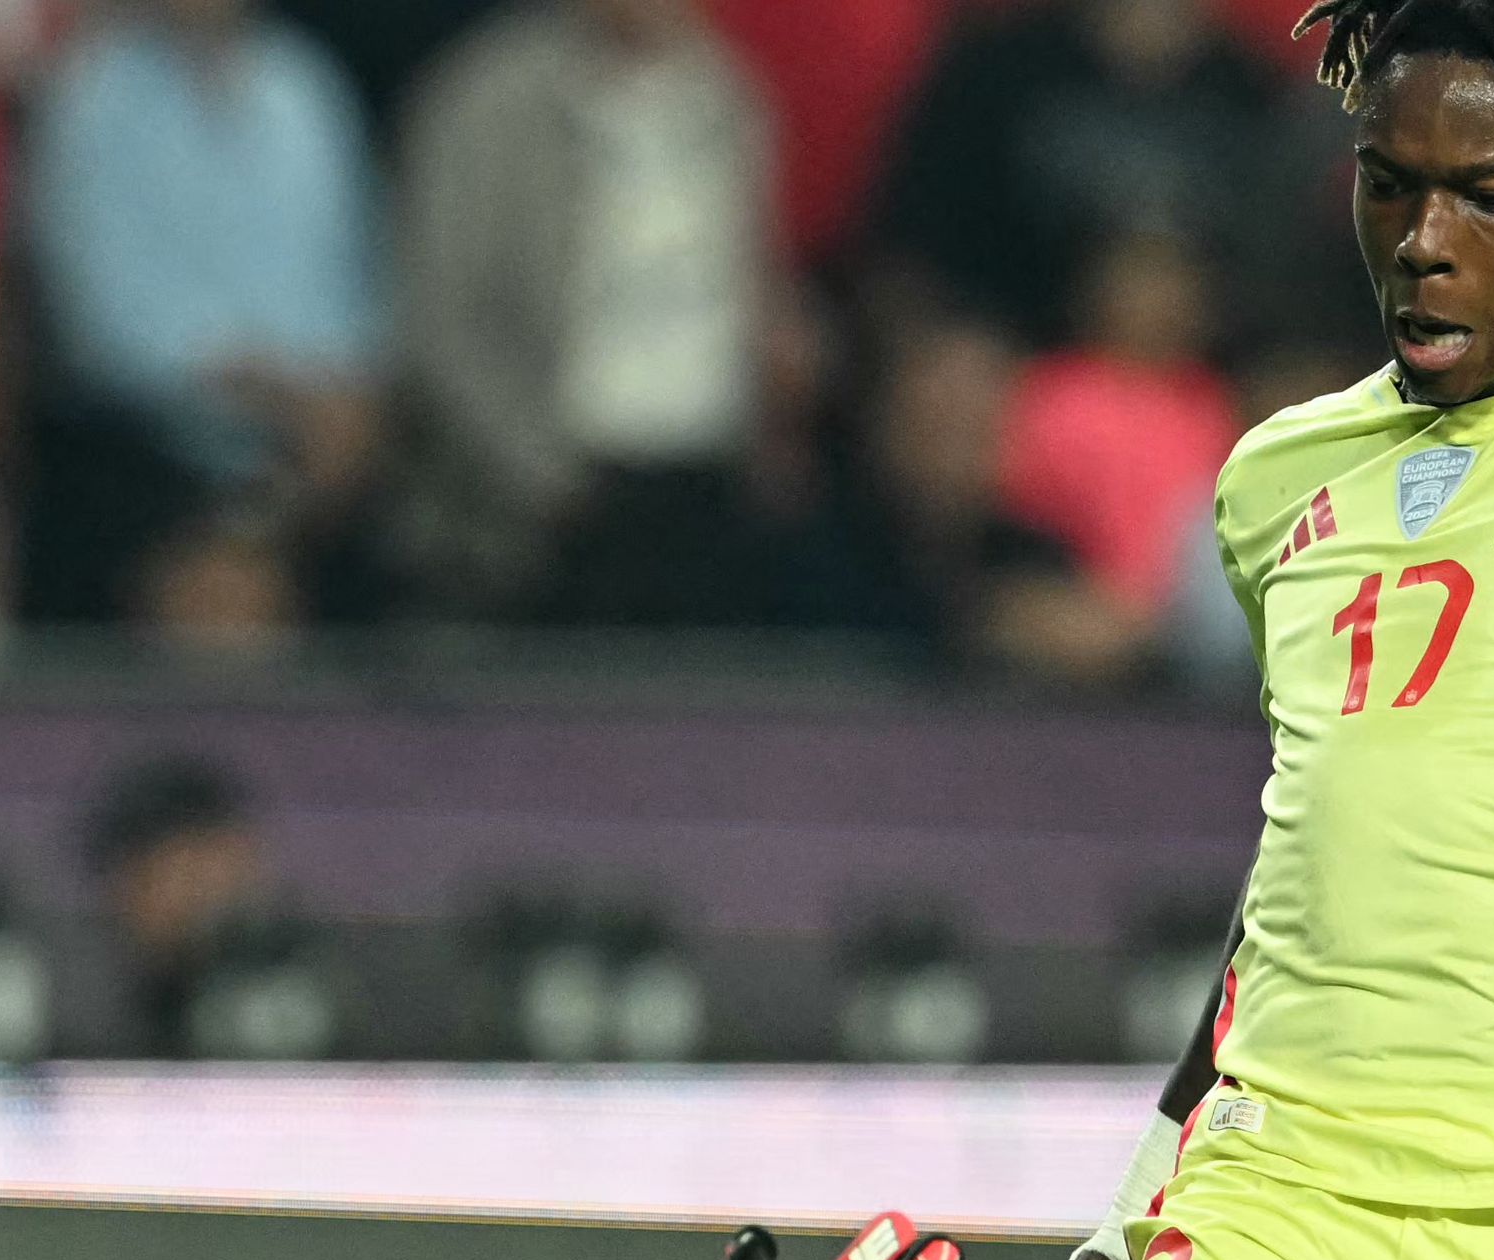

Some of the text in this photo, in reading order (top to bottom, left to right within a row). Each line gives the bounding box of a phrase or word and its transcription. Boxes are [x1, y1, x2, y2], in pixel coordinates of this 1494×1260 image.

[1425, 451, 1450, 461] UEFA
[1403, 457, 1466, 474] EUROPEAN
[1402, 467, 1462, 484] CHAMPIONS
[1332, 559, 1475, 716] 17
